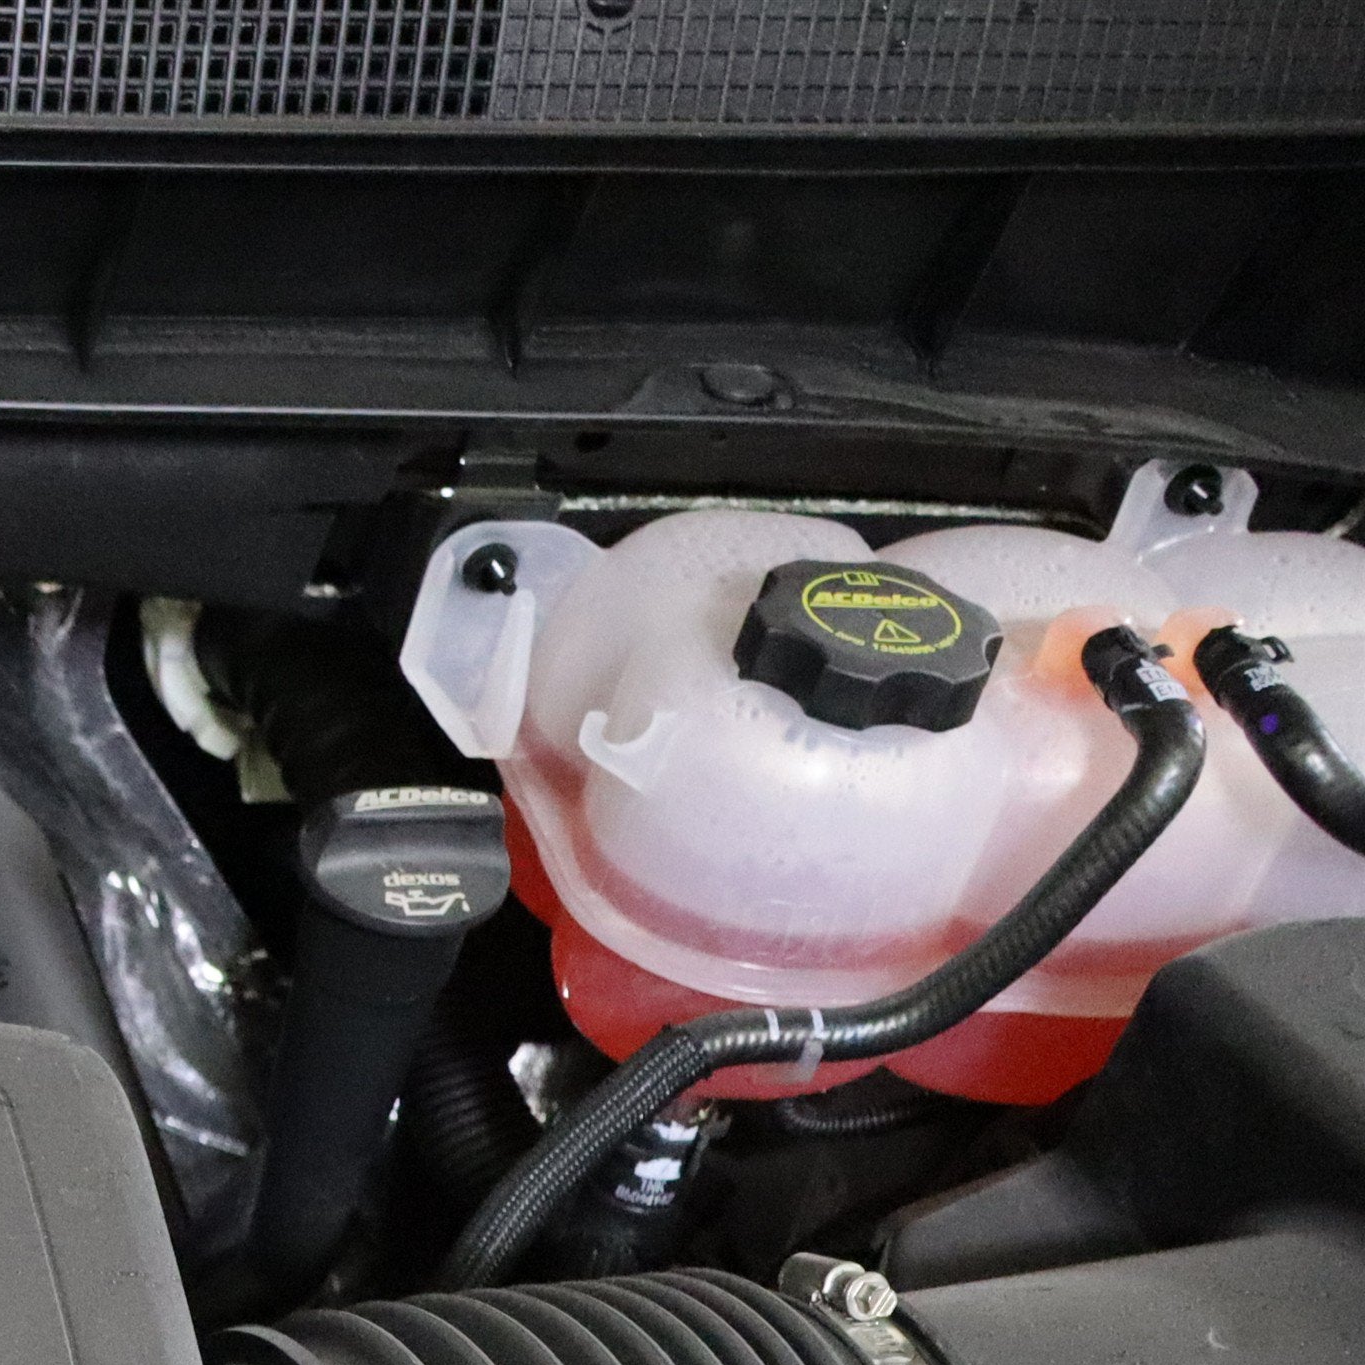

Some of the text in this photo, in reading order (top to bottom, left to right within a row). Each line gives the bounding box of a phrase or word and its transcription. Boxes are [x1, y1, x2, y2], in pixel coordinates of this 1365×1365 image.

[809, 591, 938, 608] ACDelco
[354, 787, 489, 812] ACDelco
[383, 871, 461, 887] dexos
